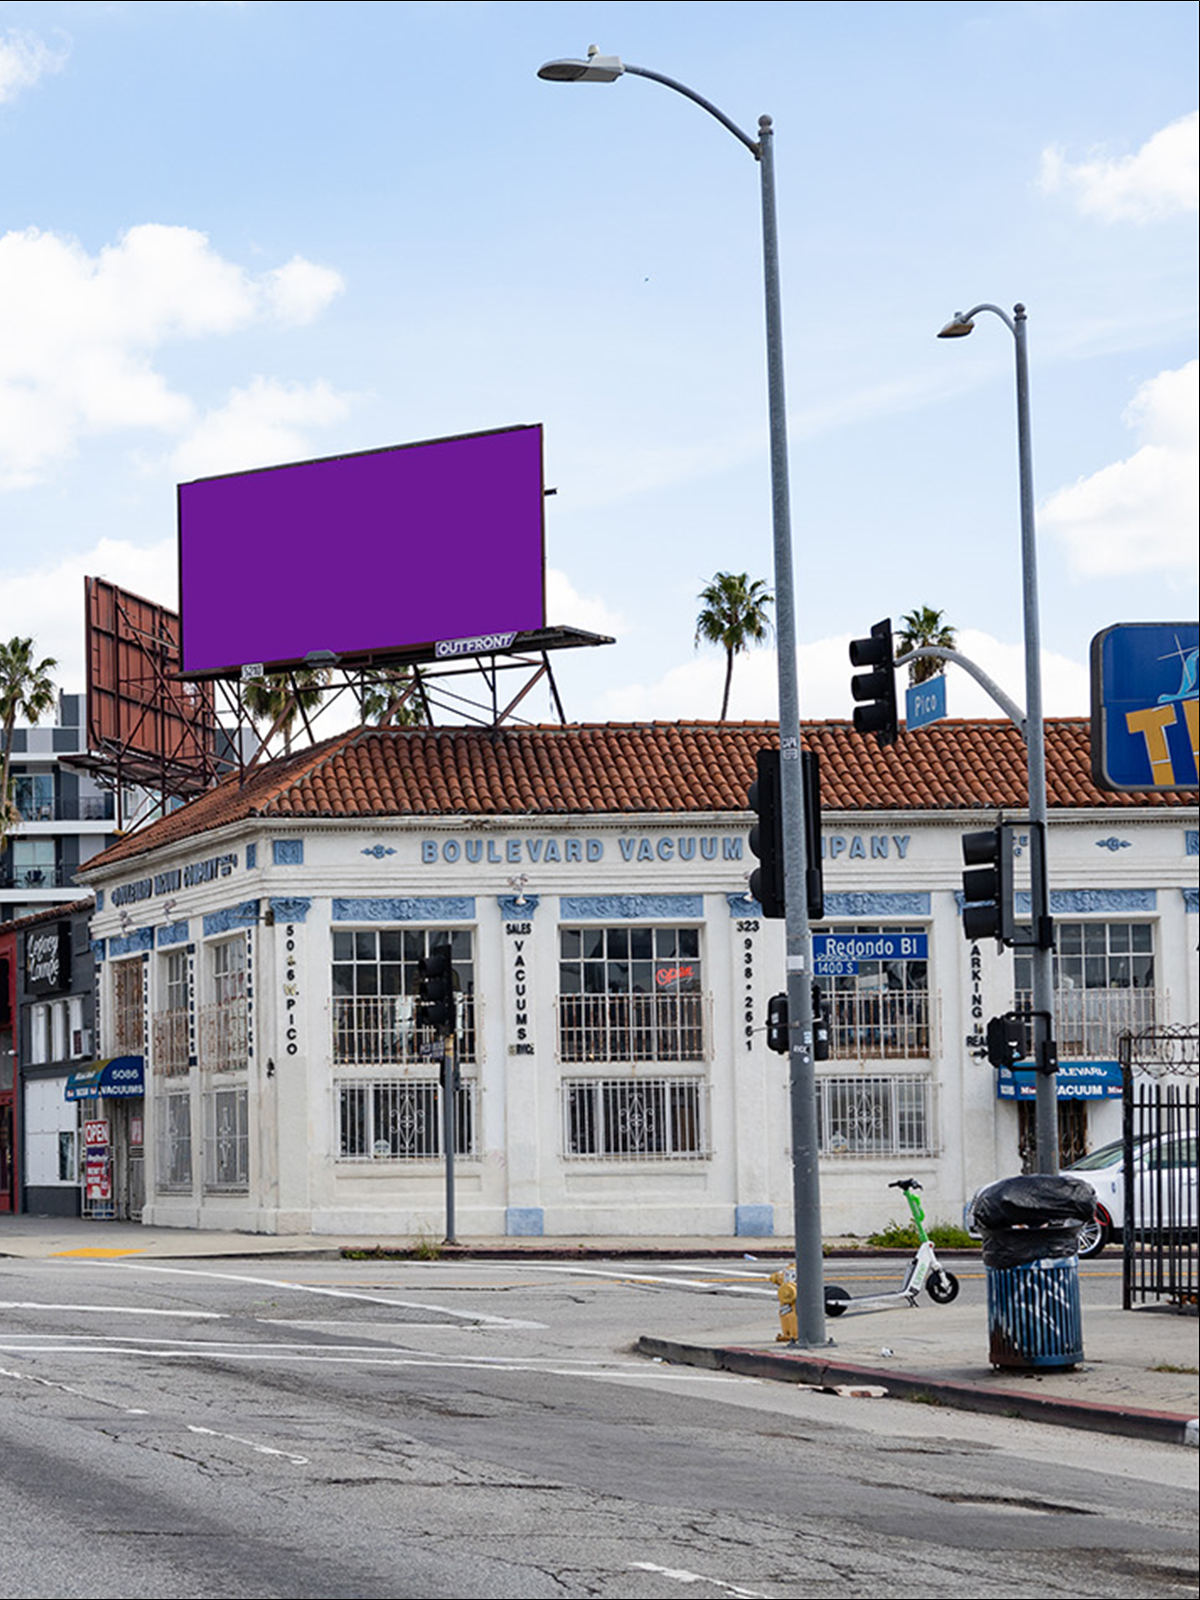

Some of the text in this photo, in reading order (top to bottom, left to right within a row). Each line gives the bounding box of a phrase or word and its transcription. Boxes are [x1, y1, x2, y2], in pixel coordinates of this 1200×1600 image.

[439, 635, 513, 655] OUTFRONT
[914, 694, 937, 717] Pico
[422, 835, 911, 863] BOULEVARD VACUUM PANY
[506, 922, 532, 935] SALES
[736, 920, 760, 932] 323
[27, 934, 58, 961] Legacy
[826, 938, 917, 955] Redondo Bl
[30, 958, 59, 985] Lounge
[656, 966, 695, 986] Open
[818, 962, 854, 974] 1400 S
[970, 939, 983, 1018] ARKING
[514, 940, 528, 1040] VACUUMS
[286, 999, 297, 1055] PICO
[966, 1035, 988, 1047] REA
[101, 1084, 144, 1095] VACUUMS
[86, 1123, 108, 1142] OPEN
